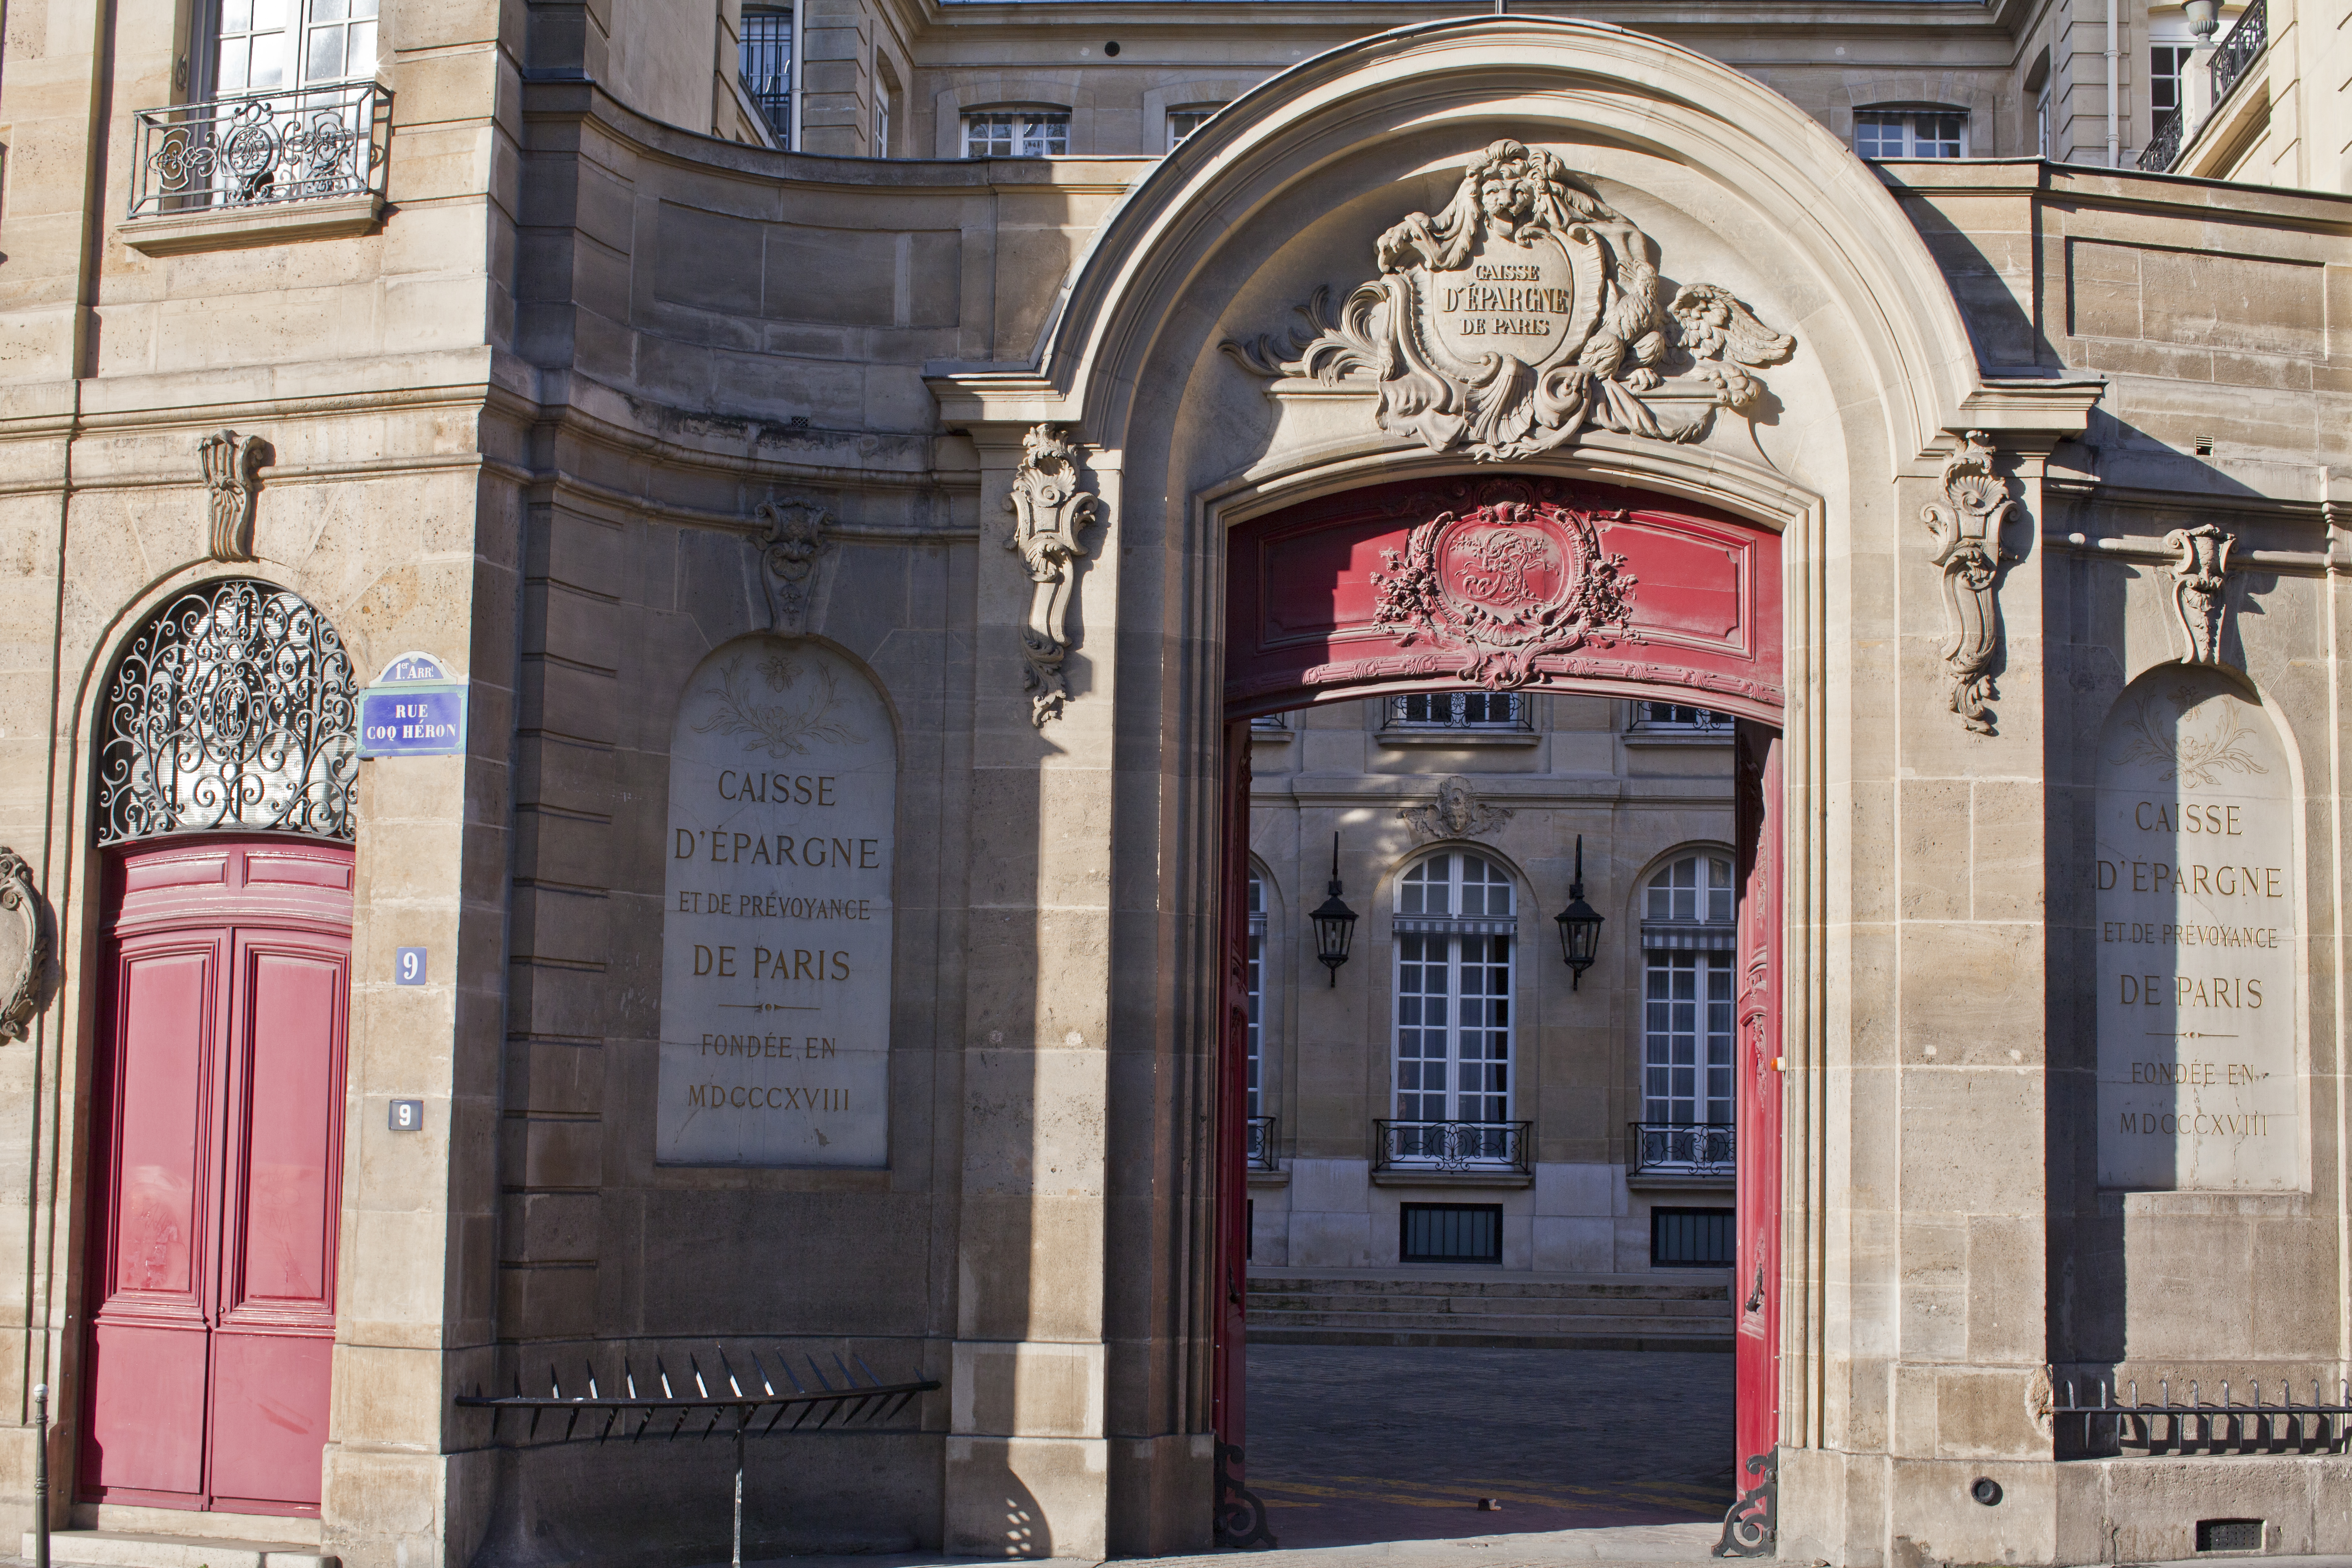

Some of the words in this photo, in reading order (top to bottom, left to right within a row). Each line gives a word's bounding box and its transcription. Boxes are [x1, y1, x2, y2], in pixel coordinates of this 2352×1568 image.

[1473, 265, 1540, 281] CAISSE
[1460, 318, 1485, 335] DE
[1492, 318, 1550, 335] PARIS
[396, 704, 428, 718] RUE
[367, 726, 397, 741] COQ
[403, 719, 456, 738] HÉRON
[718, 770, 836, 806] CAISSE
[2135, 802, 2243, 835] CAISSE
[674, 824, 880, 869] D'ÉPARGNE
[2097, 855, 2284, 897] D'ÉPARGNE
[678, 891, 702, 912] ET
[708, 893, 732, 914] DE
[740, 892, 870, 920] PRÉVOYANCE
[2104, 922, 2126, 942] ET
[2132, 923, 2155, 943] DE
[2163, 920, 2278, 948] PRÉVOYANCE
[403, 952, 418, 980] 9
[693, 944, 737, 977] DE
[753, 947, 850, 981] PARIS
[2120, 975, 2161, 1005] DE
[2177, 976, 2263, 1008] PARIS
[701, 1032, 792, 1058] FONDÉE
[806, 1037, 836, 1059] EN
[2132, 1059, 2215, 1084] FONDÉE
[2228, 1064, 2254, 1085] EN
[688, 1085, 849, 1111] MDCCCXVIII
[399, 1104, 411, 1126] 9
[2120, 1113, 2267, 1135] MDCCCXVIII
